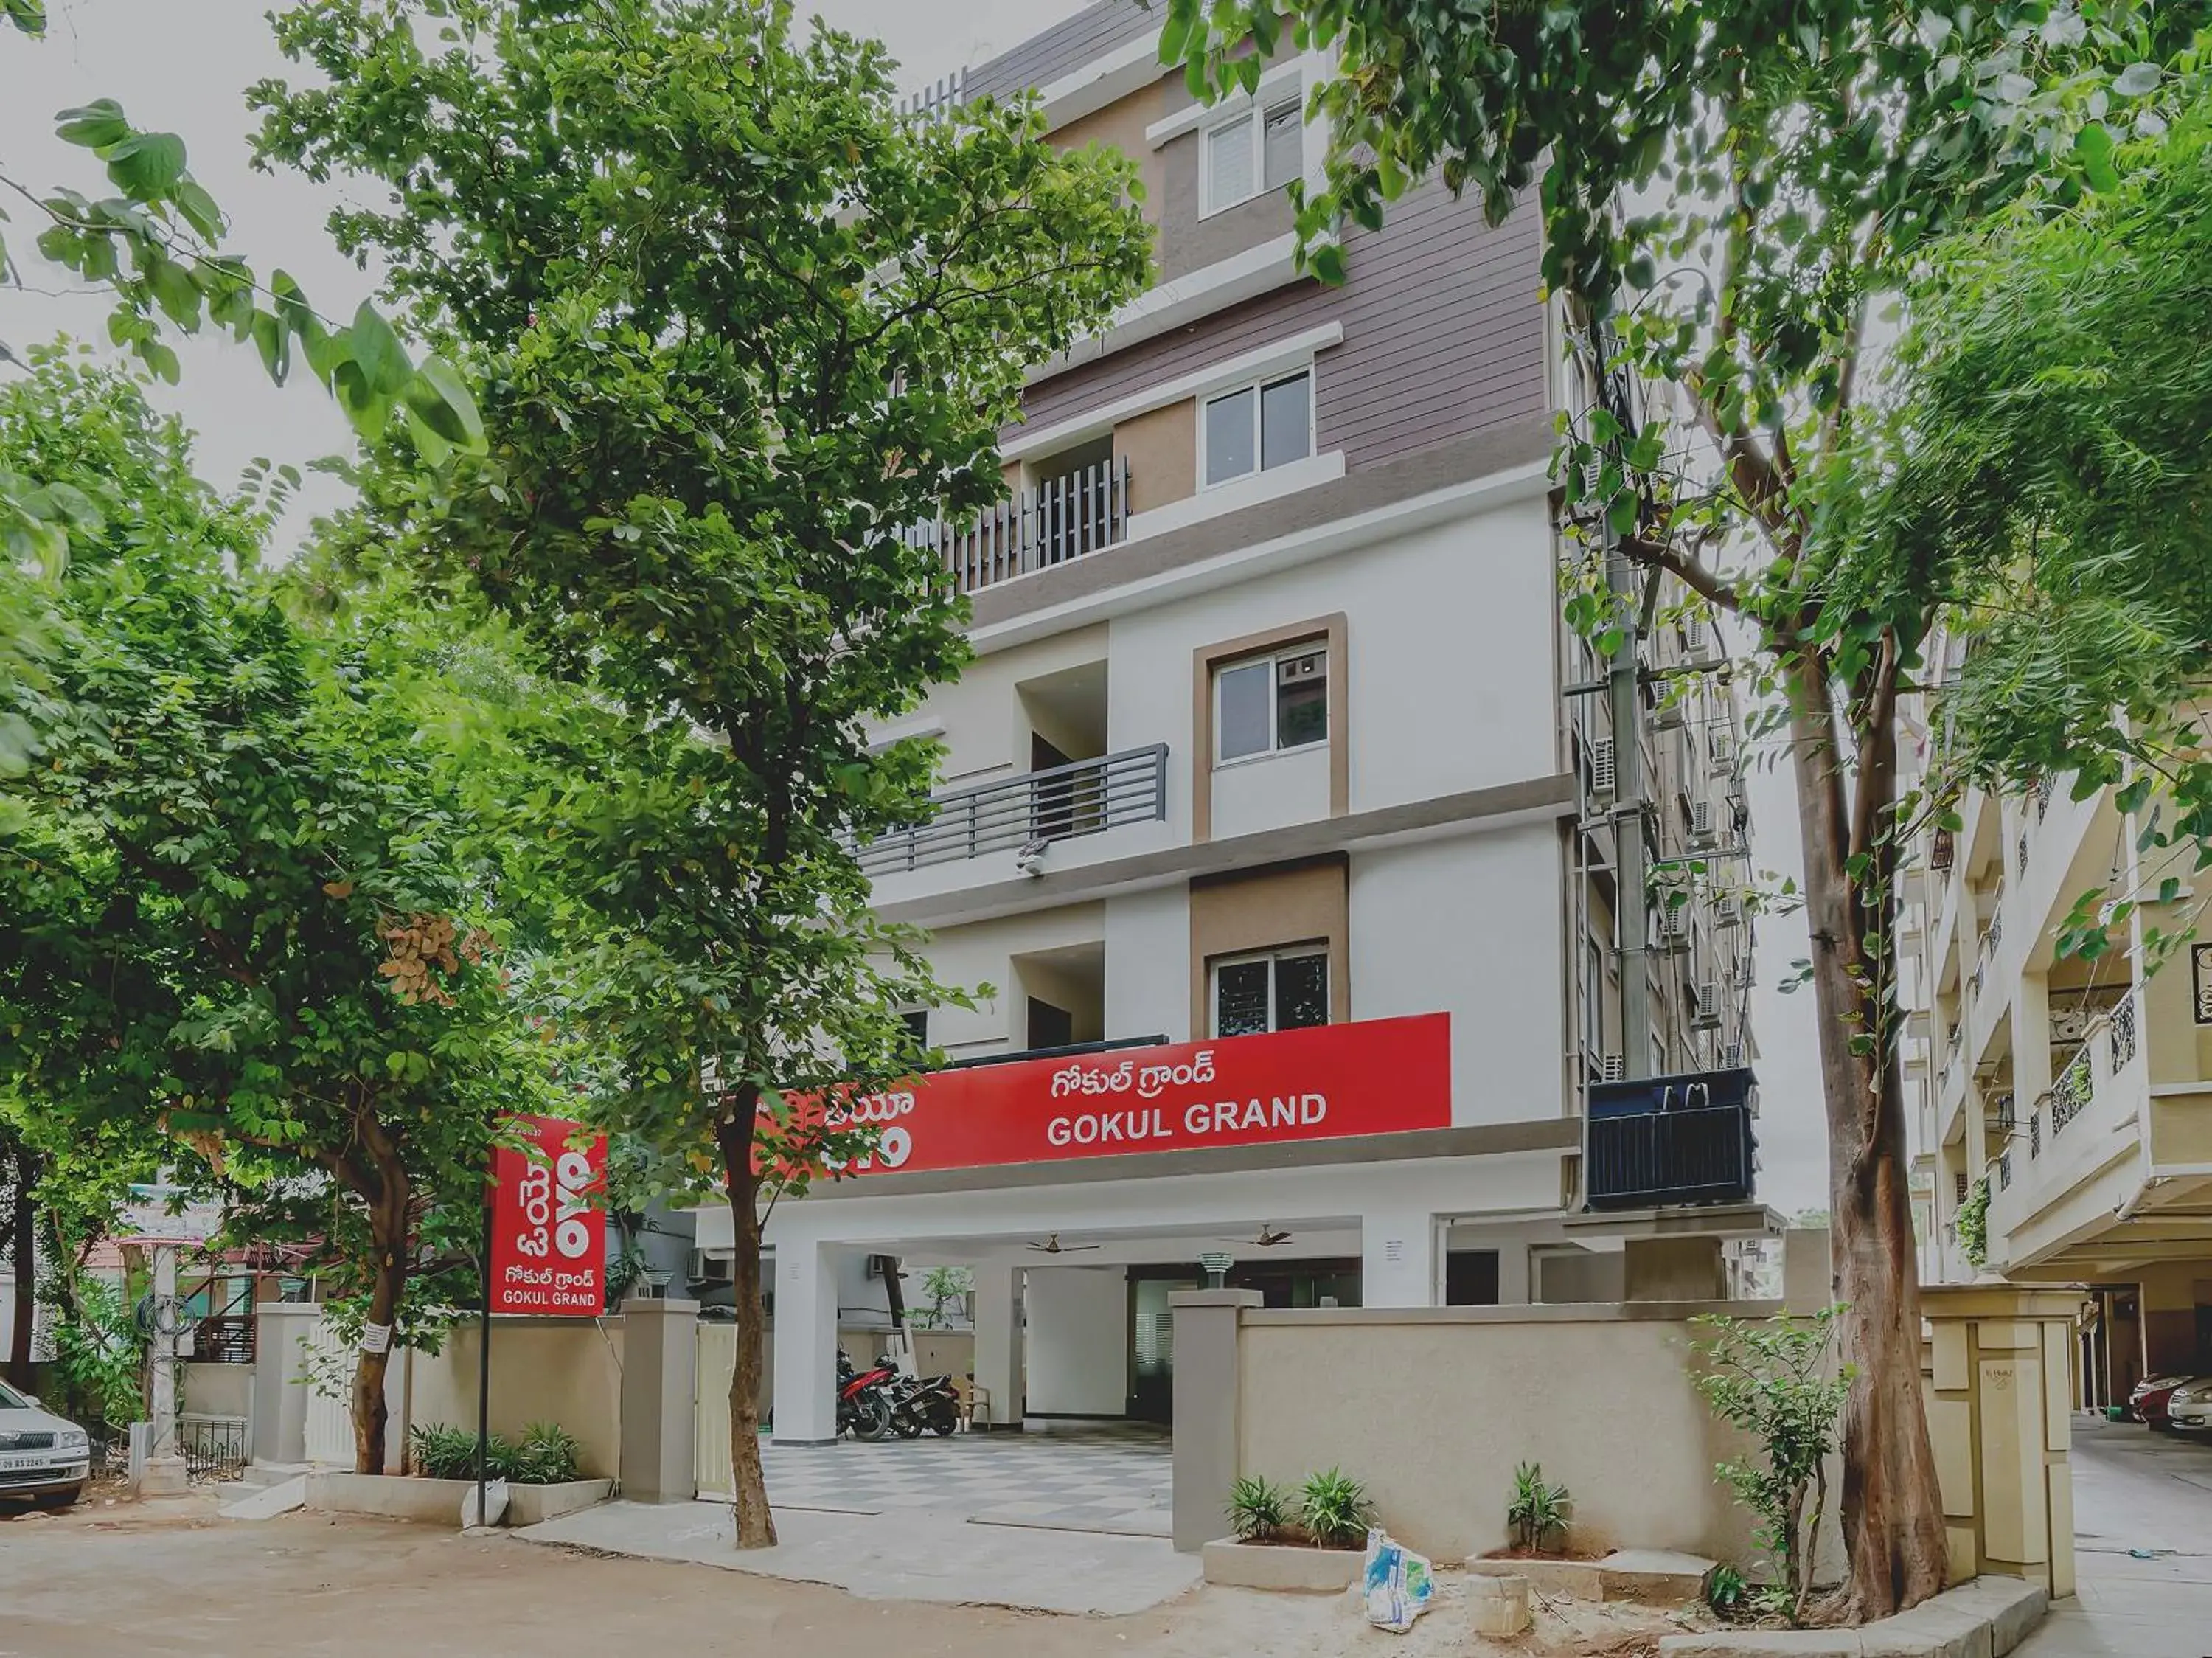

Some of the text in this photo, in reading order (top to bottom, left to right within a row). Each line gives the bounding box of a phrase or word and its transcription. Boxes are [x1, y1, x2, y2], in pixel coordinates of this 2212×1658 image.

[1051, 1049, 1215, 1099] గోకుల్ గ్రాండ్
[1047, 1093, 1327, 1146] GOKUL GRAND
[554, 1151, 591, 1258] OYO
[503, 1289, 596, 1307] GOKUL GRAND
[504, 1264, 552, 1285] గోకుల్
